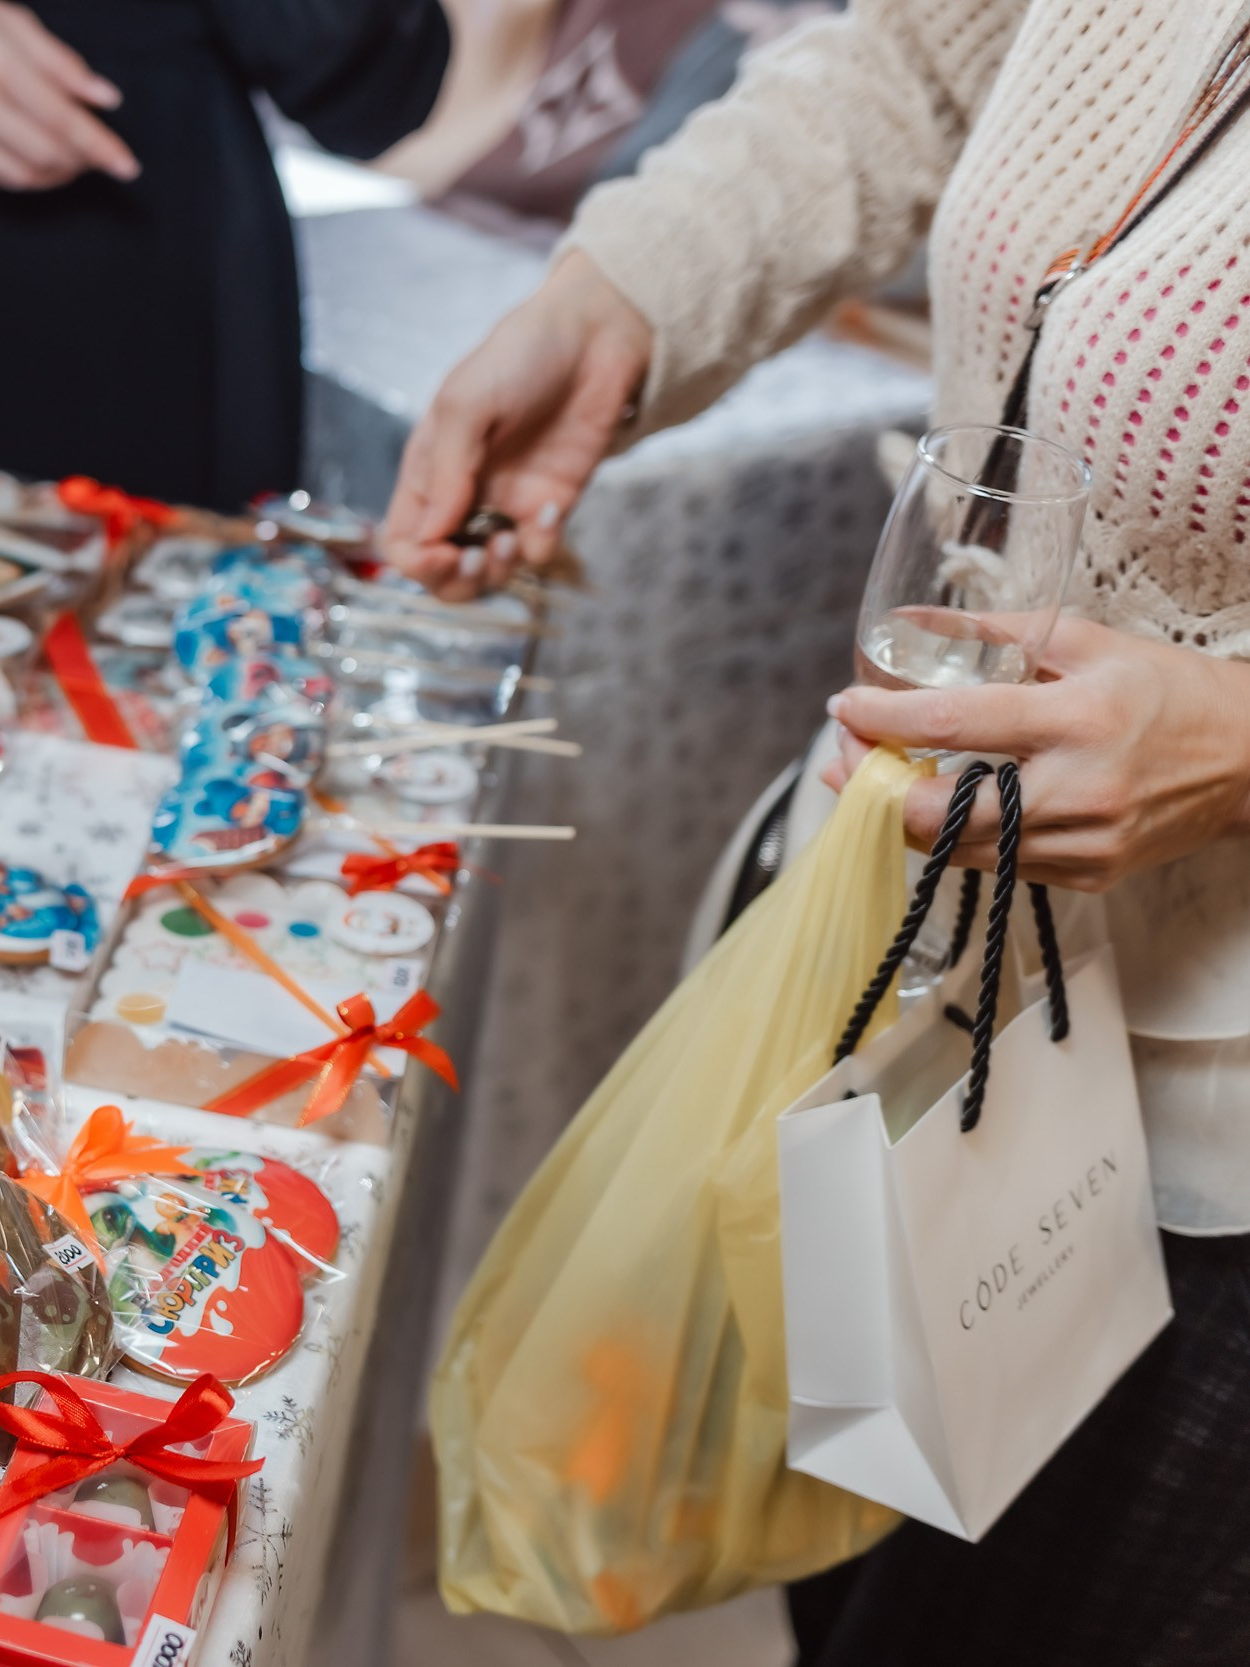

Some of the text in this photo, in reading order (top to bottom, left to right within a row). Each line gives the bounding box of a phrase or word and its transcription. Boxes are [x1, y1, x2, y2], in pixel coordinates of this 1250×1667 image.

[1038, 1151, 1118, 1245] SEVEN
[141, 1228, 246, 1335] СЮРПРИЗ
[152, 1633, 184, 1667] 000
